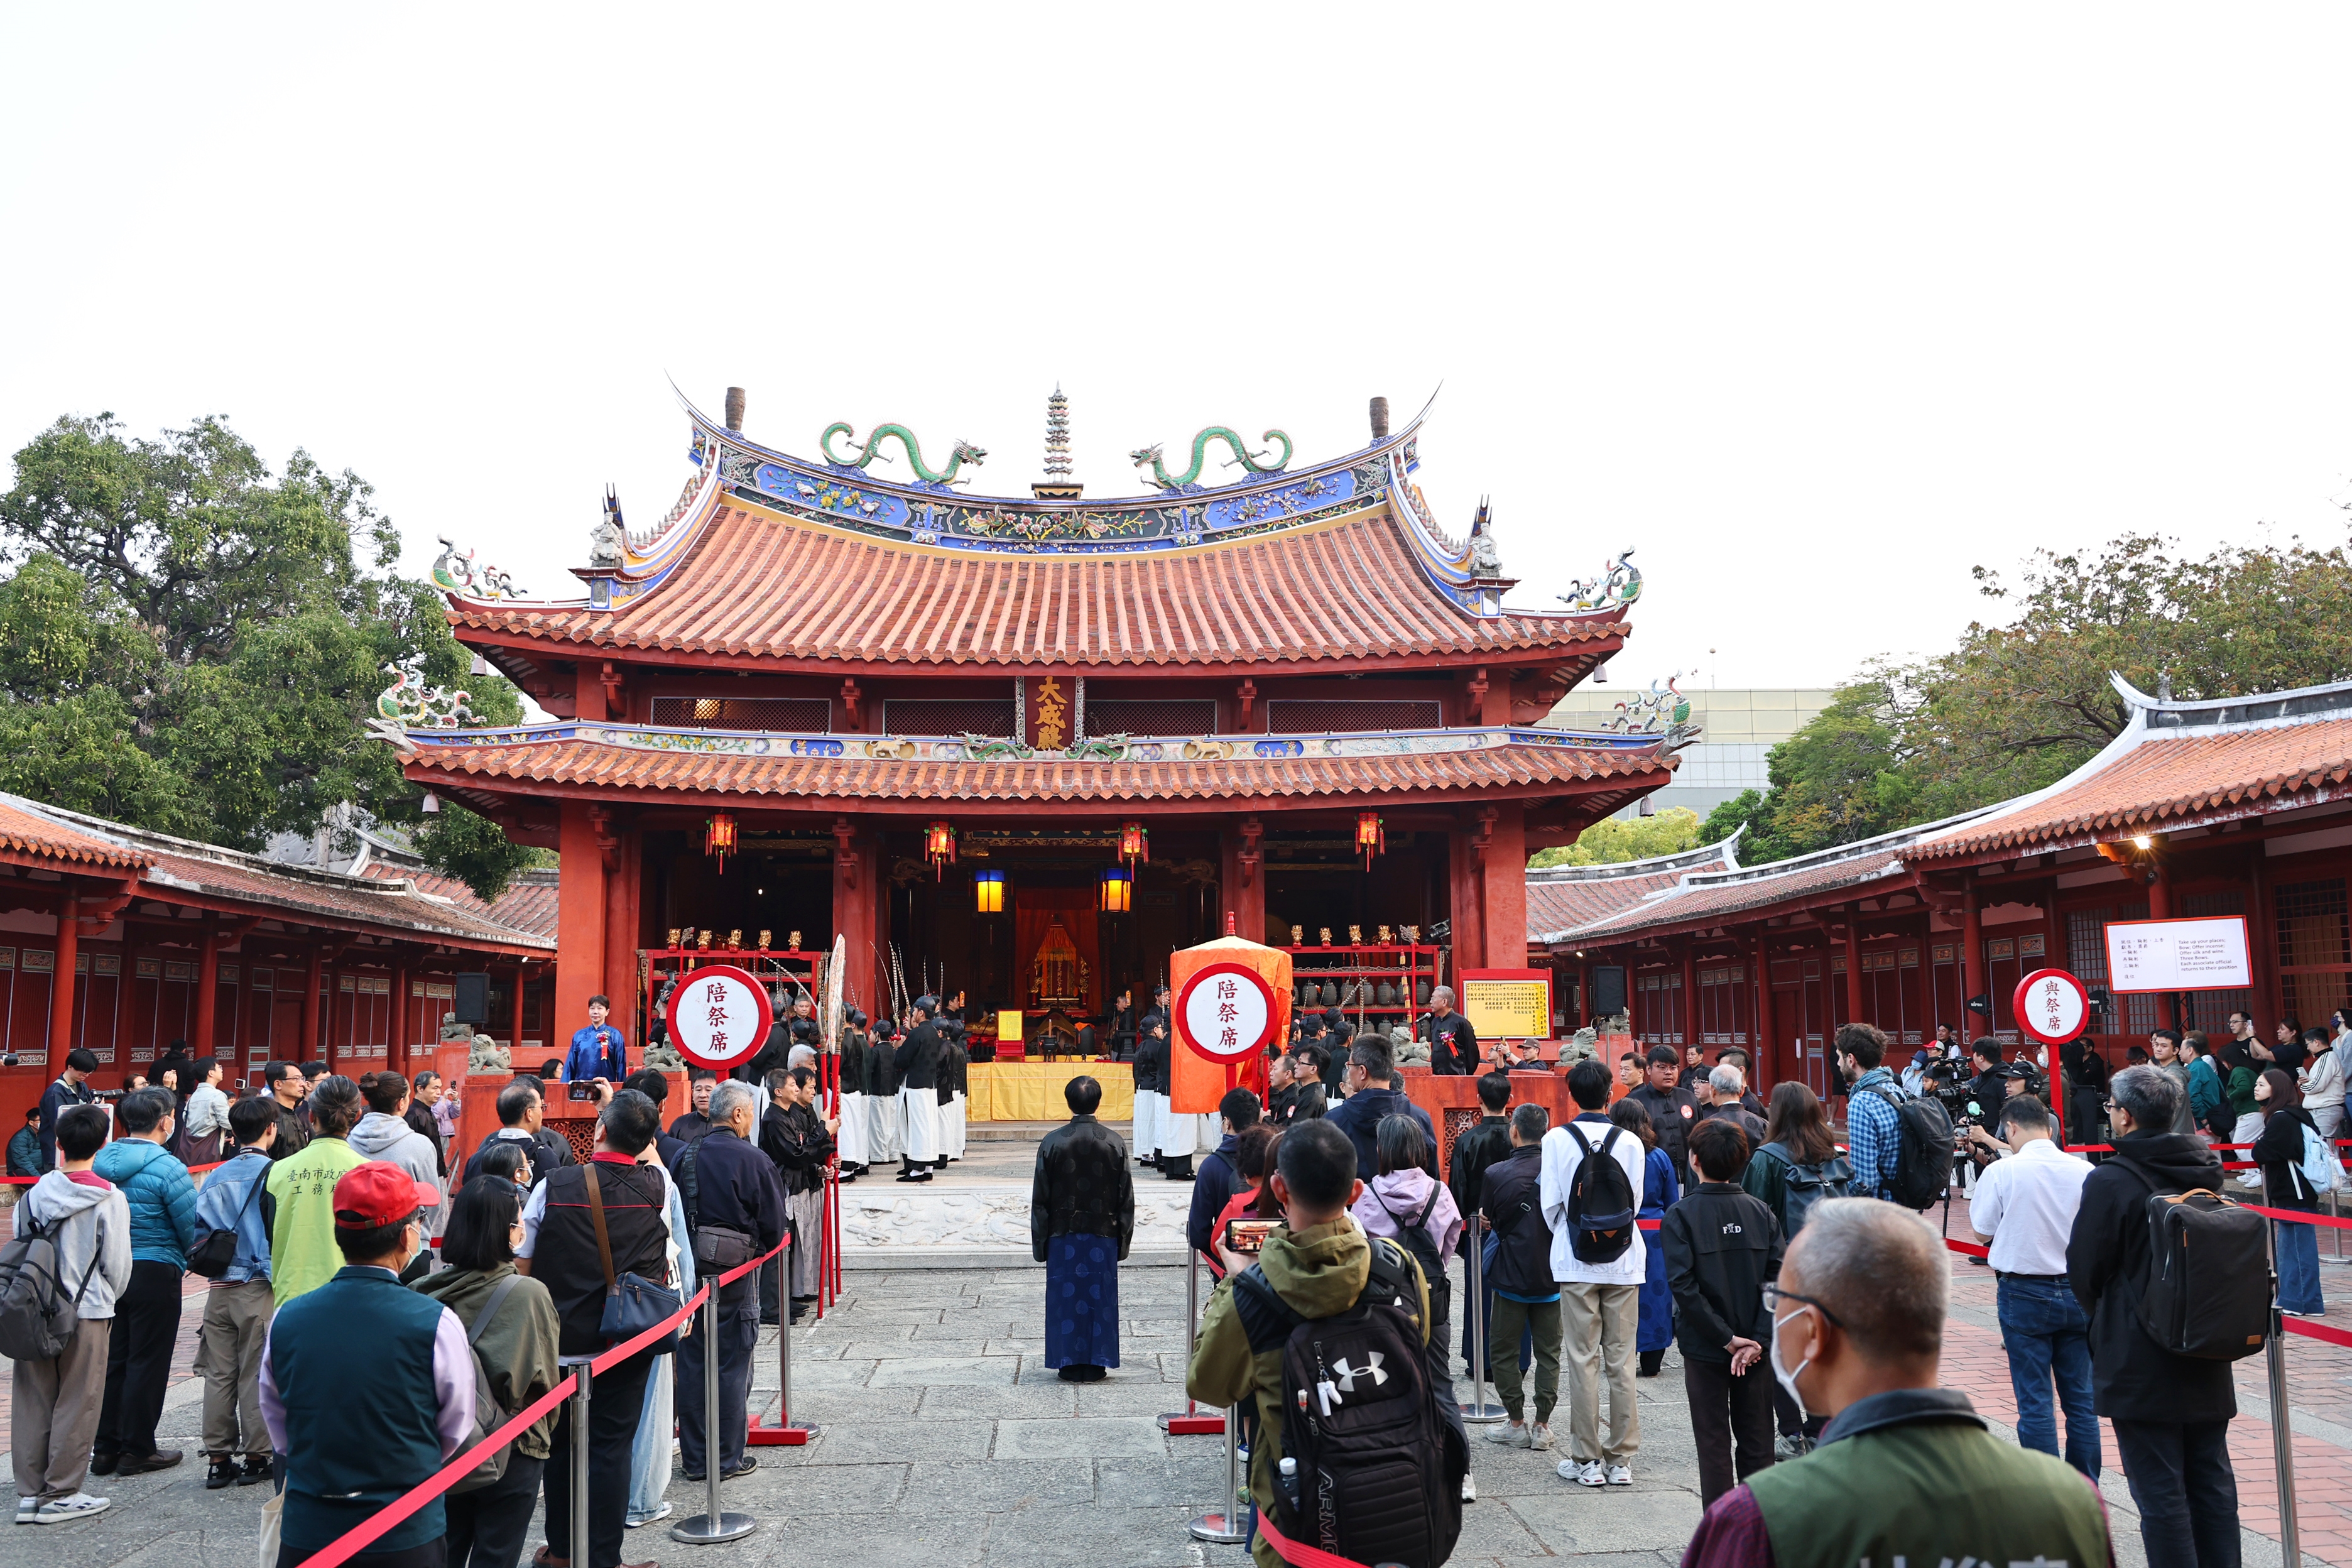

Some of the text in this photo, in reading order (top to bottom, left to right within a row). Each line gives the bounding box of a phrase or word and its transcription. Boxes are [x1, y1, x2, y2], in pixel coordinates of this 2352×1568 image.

[1035, 675, 1069, 751] 大成殿
[706, 983, 729, 1054] 陪祭席
[1217, 979, 1239, 1048] 陪祭席
[2045, 980, 2061, 1032] 與祭席
